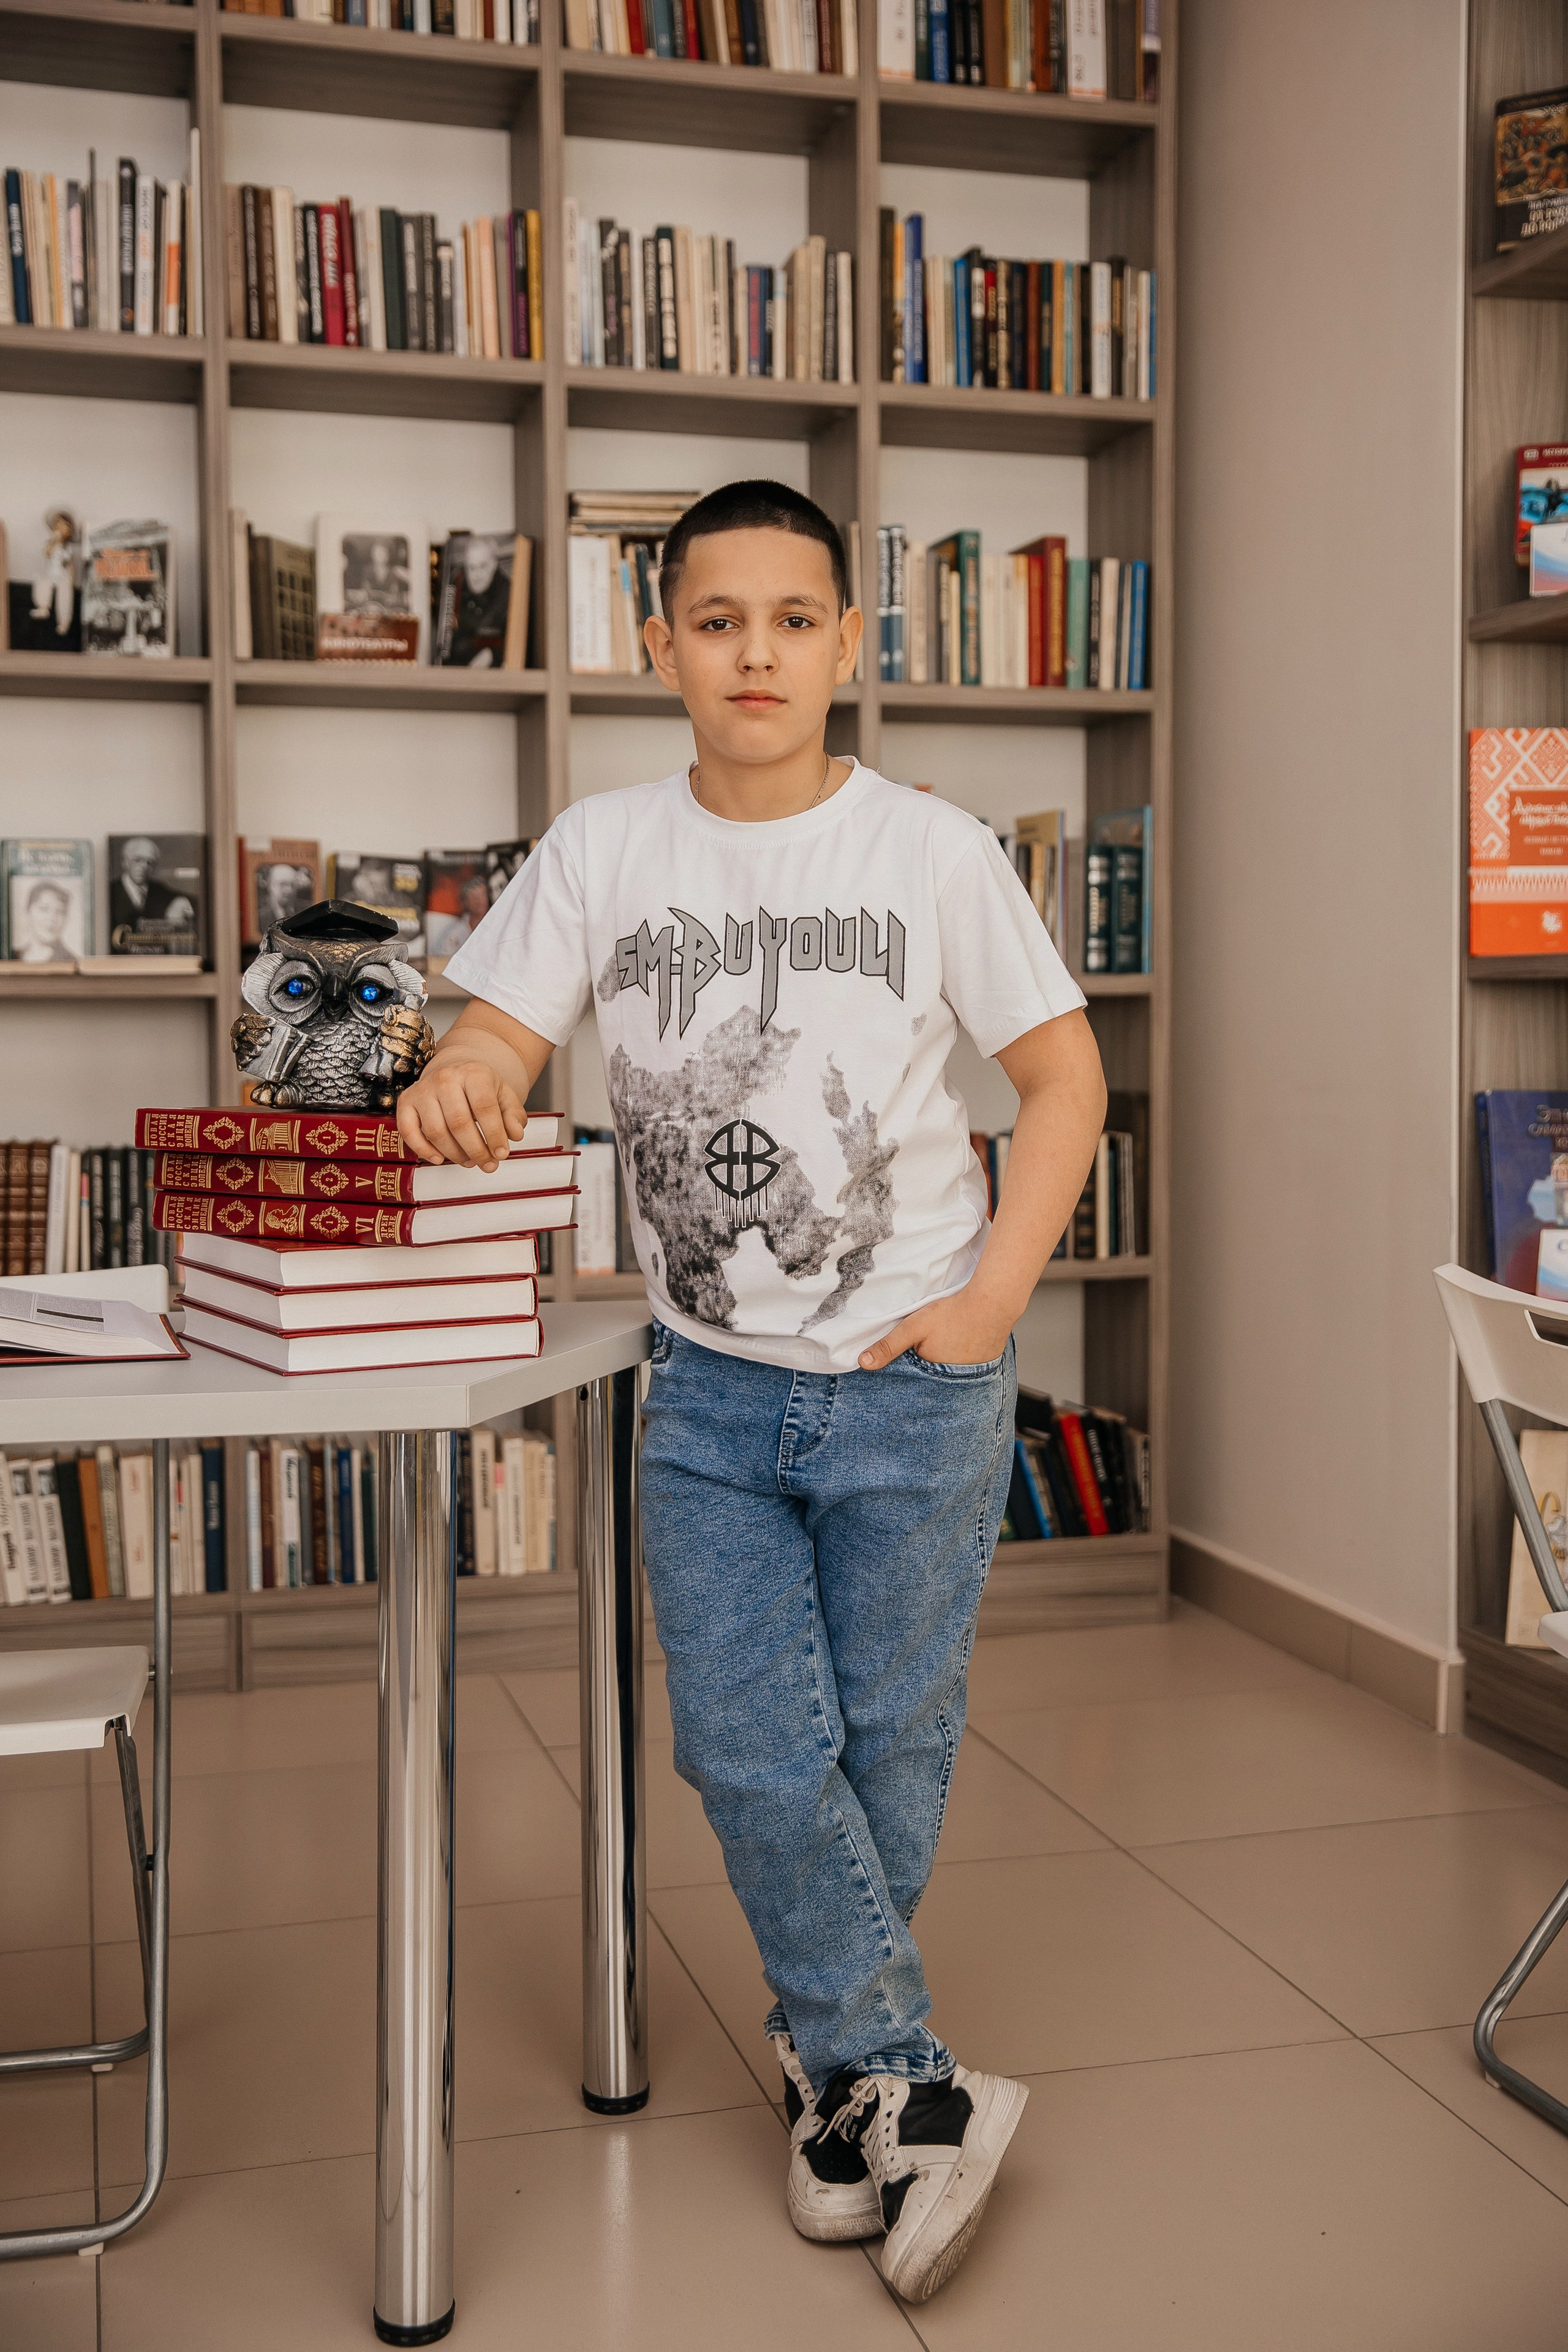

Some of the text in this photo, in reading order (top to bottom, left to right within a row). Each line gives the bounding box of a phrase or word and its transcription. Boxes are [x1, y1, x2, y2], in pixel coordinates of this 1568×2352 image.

[151, 1114, 159, 1146] НОВАЯ
[159, 1114, 168, 1146] РОССИЙ
[168, 1114, 176, 1147] СКАЯ
[185, 1115, 194, 1148] ЛОПЕДИЯ
[355, 1128, 376, 1150] III
[355, 1177, 373, 1187] V
[168, 1196, 177, 1228] НОВАЯ
[176, 1196, 186, 1229] РОССИЙ
[184, 1197, 193, 1229] СКАЯ
[192, 1197, 201, 1229] ЭНЦИК
[200, 1198, 209, 1231] ЛОПЕДИЯ
[356, 1217, 374, 1234] VI
